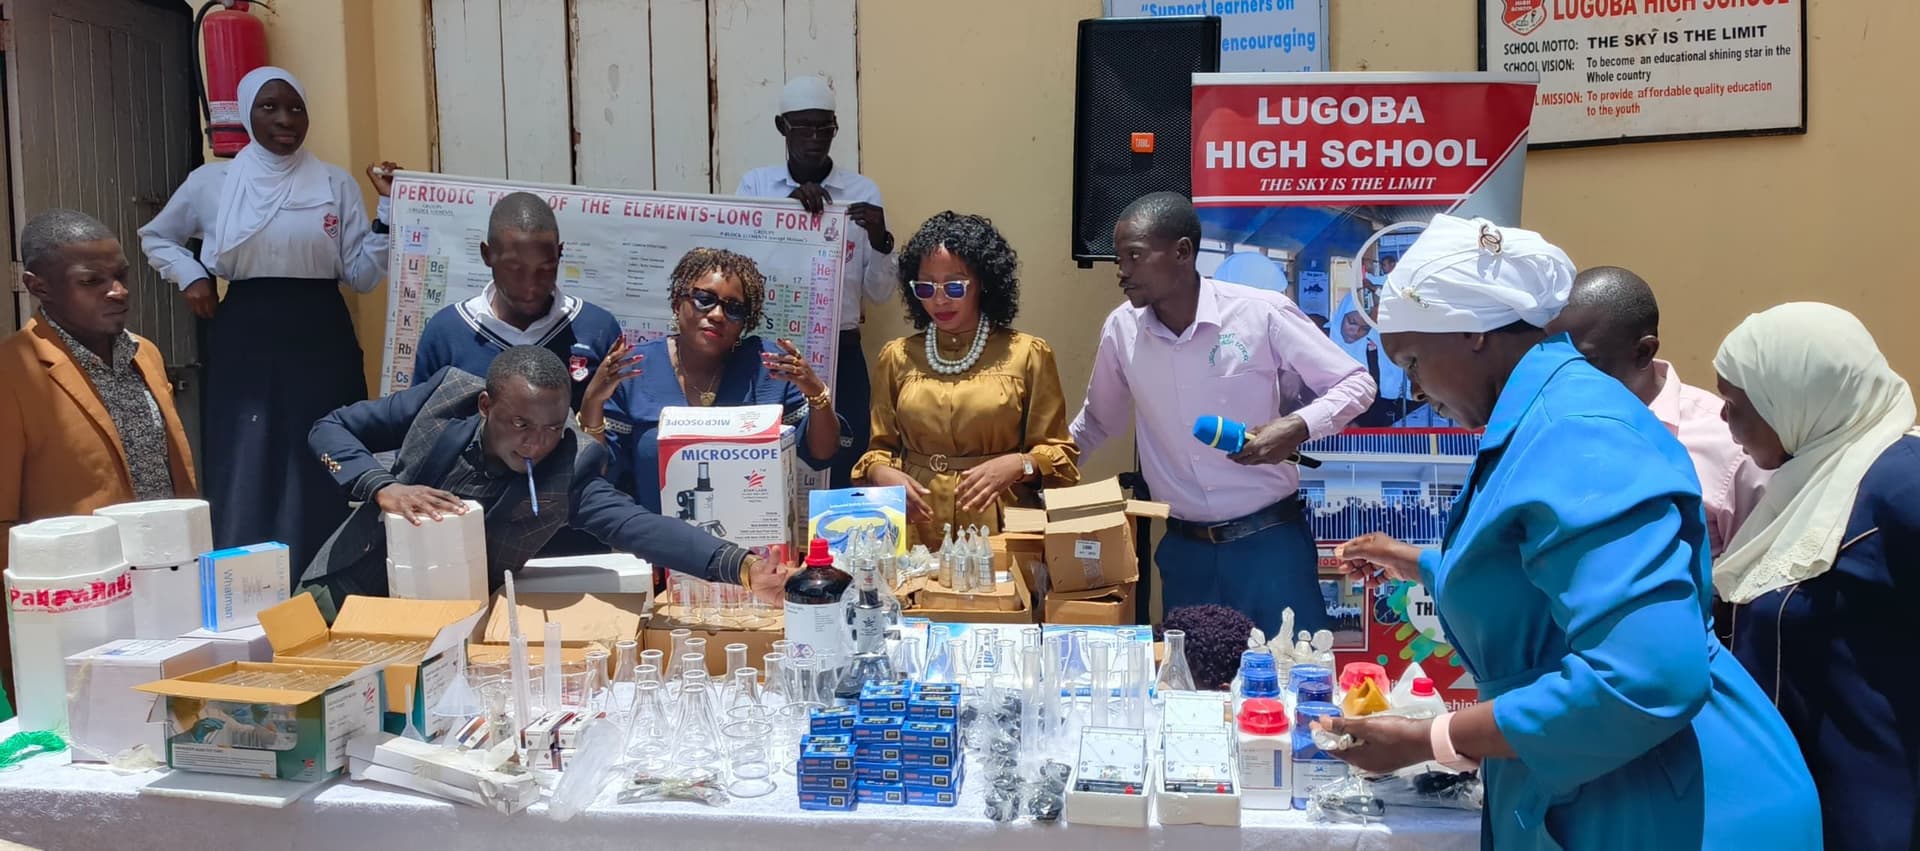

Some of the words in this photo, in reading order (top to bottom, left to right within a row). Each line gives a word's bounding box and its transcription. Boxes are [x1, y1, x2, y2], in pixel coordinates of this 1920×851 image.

[1211, 0, 1273, 15] learners
[1277, 0, 1295, 11] on
[1222, 28, 1316, 53] encouraging
[1504, 42, 1540, 55] SCHOOL
[1542, 39, 1579, 52] MOTTO:
[1587, 36, 1619, 49] THE
[1624, 32, 1657, 47] SKY
[1663, 31, 1679, 44] IS
[1684, 29, 1716, 42] THE
[1722, 25, 1768, 40] LIMIT
[1542, 59, 1575, 72] VISION:
[1587, 57, 1598, 68] To
[1600, 56, 1635, 67] become
[1640, 55, 1652, 65] an
[1654, 49, 1707, 64] educational
[1709, 47, 1742, 61] shining
[1744, 46, 1762, 58] star
[1765, 45, 1774, 56] in
[1776, 44, 1791, 56] the
[1587, 71, 1615, 83] Whole
[1616, 70, 1652, 82] country
[1542, 91, 1583, 105] MISSION:
[1587, 91, 1598, 101] To
[1600, 88, 1633, 103] provide
[1638, 84, 1692, 98] affordable
[1694, 82, 1725, 97] quality
[1727, 80, 1773, 93] education
[1258, 96, 1425, 125] LUGOBA
[1587, 106, 1596, 116] to
[1599, 105, 1613, 116] the
[1616, 103, 1641, 117] youth
[1206, 140, 1307, 168] HIGH
[1321, 139, 1488, 168] SCHOOL
[1260, 178, 1294, 191] THE
[1296, 178, 1329, 191] SKY
[1330, 177, 1347, 191] IS
[1350, 177, 1385, 190] THE
[1388, 177, 1437, 190] LIMIT
[399, 185, 475, 204] PERIODIC
[548, 195, 568, 211] OF
[581, 198, 611, 214] THE
[624, 201, 763, 227] ELEMENTS-LONG
[776, 212, 822, 232] FORM
[412, 232, 420, 243] H
[409, 259, 418, 271] Li
[431, 261, 444, 273] Be
[817, 264, 831, 276] He
[404, 287, 416, 299] Na
[427, 289, 441, 303] Mg
[794, 291, 801, 303] F
[816, 293, 828, 306] Ne
[404, 315, 411, 327] K
[766, 318, 774, 330] S
[814, 322, 827, 335] Ar
[398, 343, 412, 355] Rb
[812, 351, 825, 364] Kr
[396, 371, 409, 384] Cs
[666, 418, 731, 426] MICROSCOPE
[681, 449, 778, 461] MICROSCOPE
[804, 474, 815, 486] Lu
[224, 568, 233, 619] Whatman
